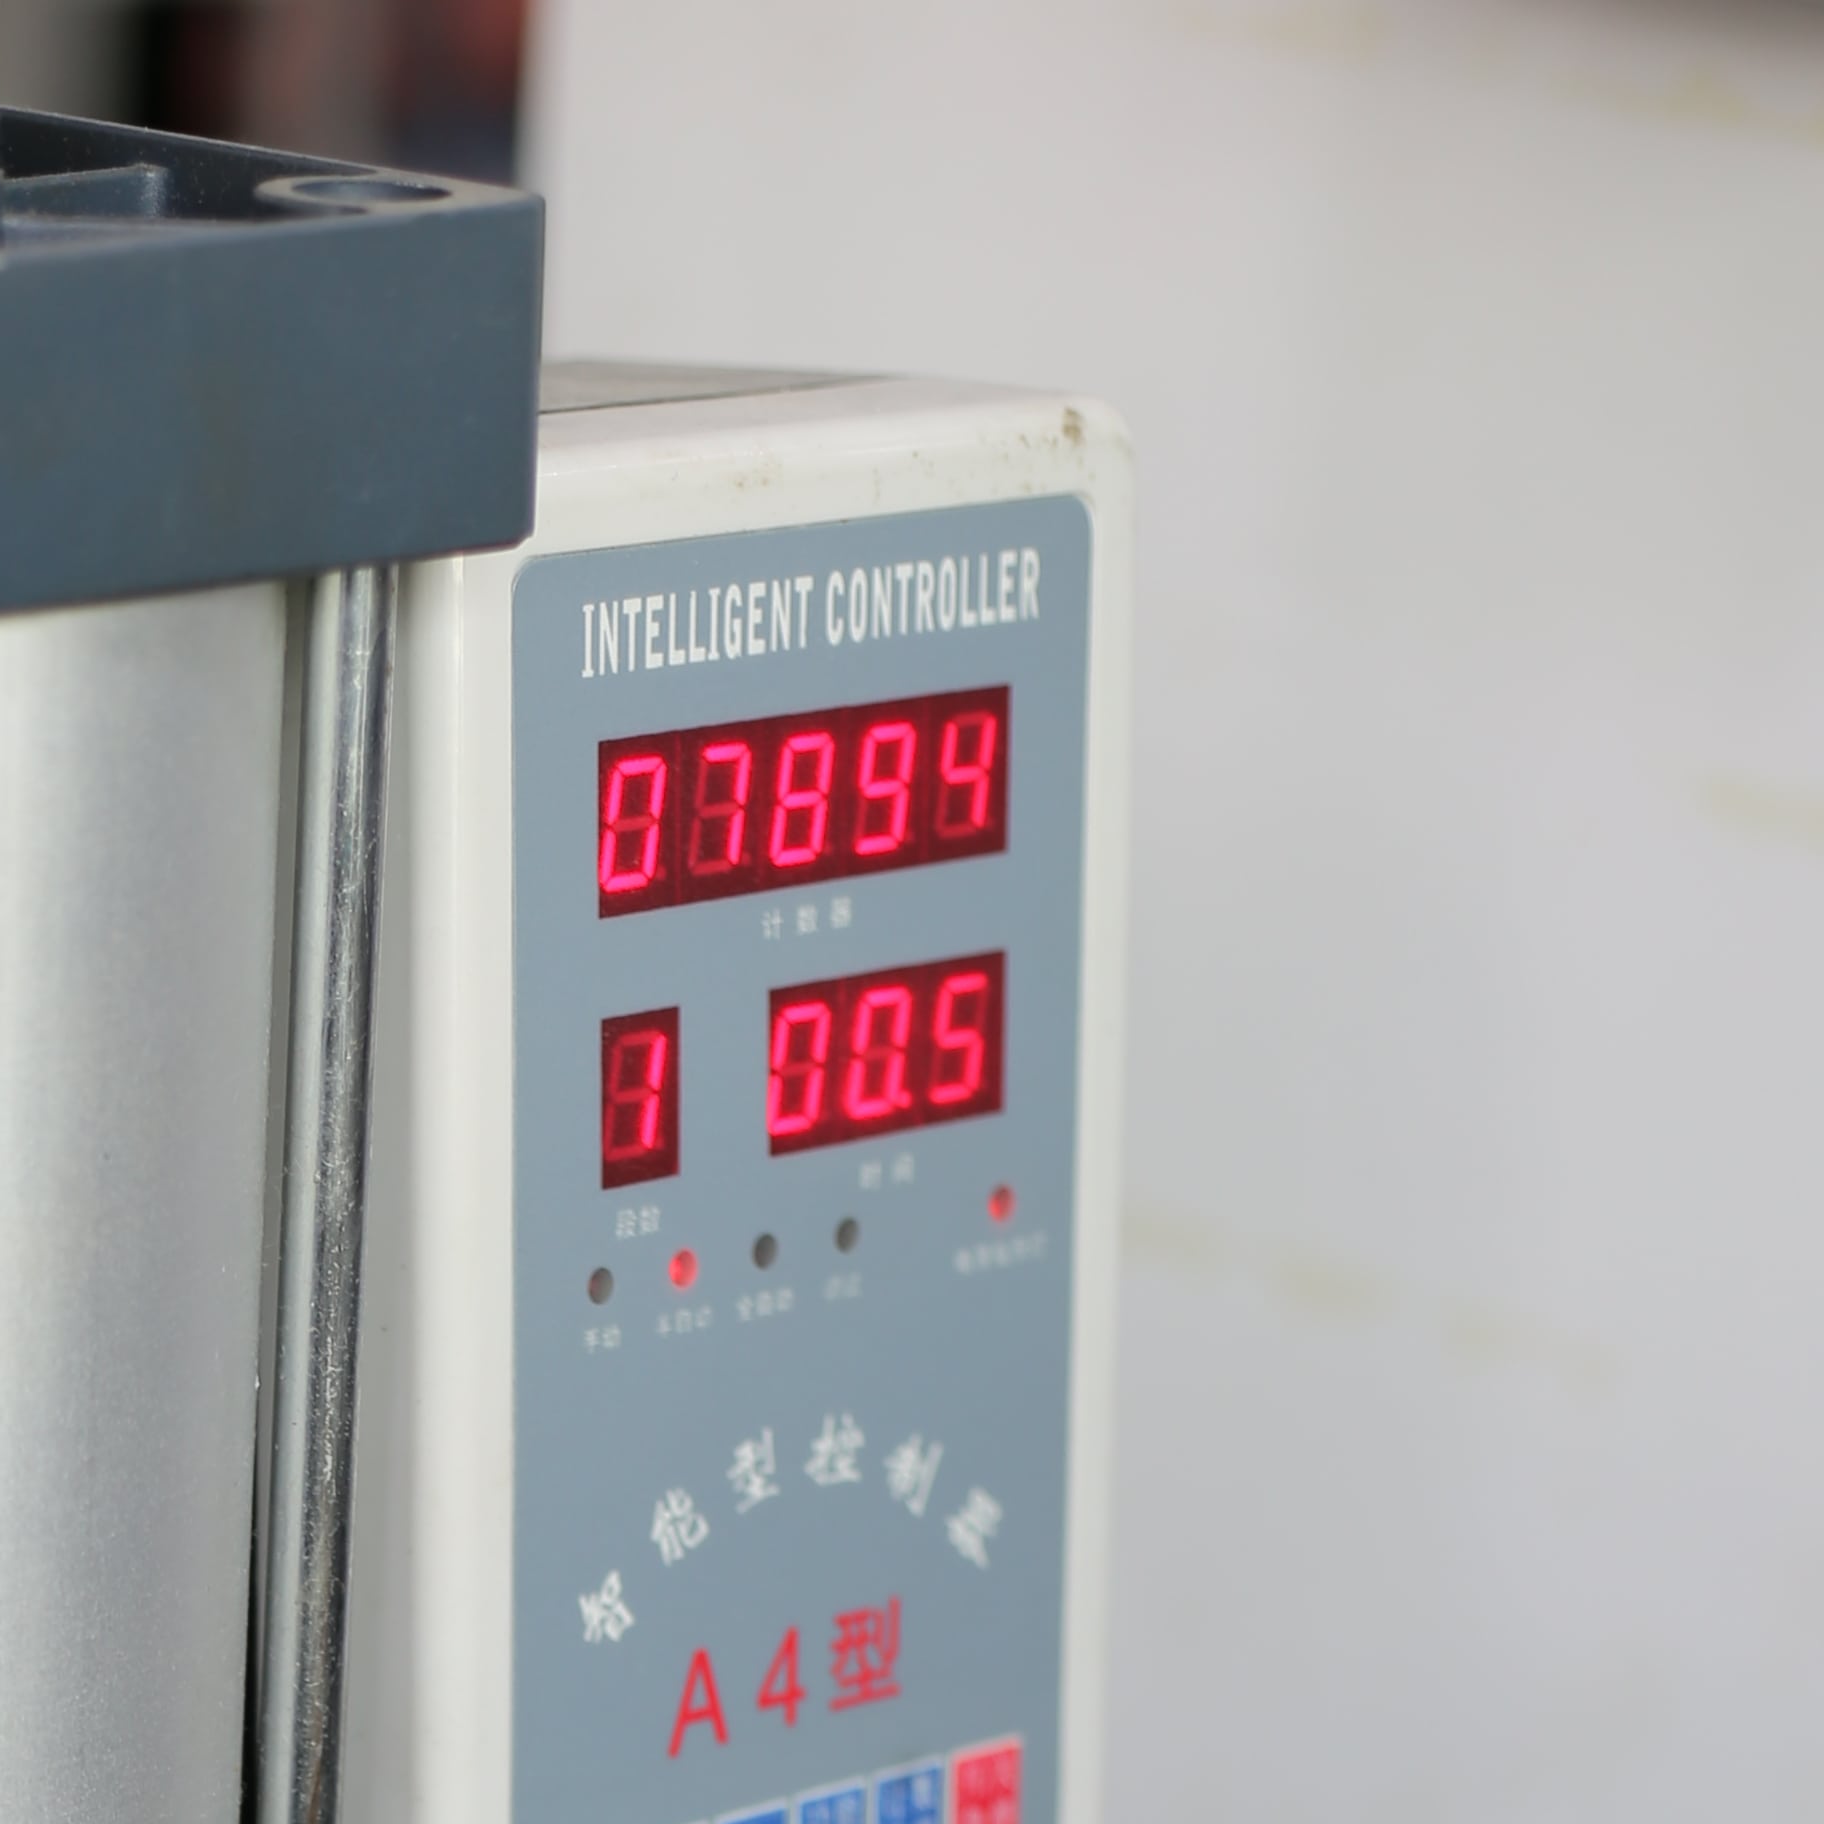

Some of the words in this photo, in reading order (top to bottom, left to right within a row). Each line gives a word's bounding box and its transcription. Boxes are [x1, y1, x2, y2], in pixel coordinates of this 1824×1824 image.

[581, 575, 814, 679] INTELLIGENT
[825, 546, 1041, 647] CONTROLLER
[598, 711, 998, 894] 07894
[761, 896, 853, 940] 计数器
[858, 1152, 916, 1190] 时间
[578, 1411, 1004, 1645] 智能型控制器
